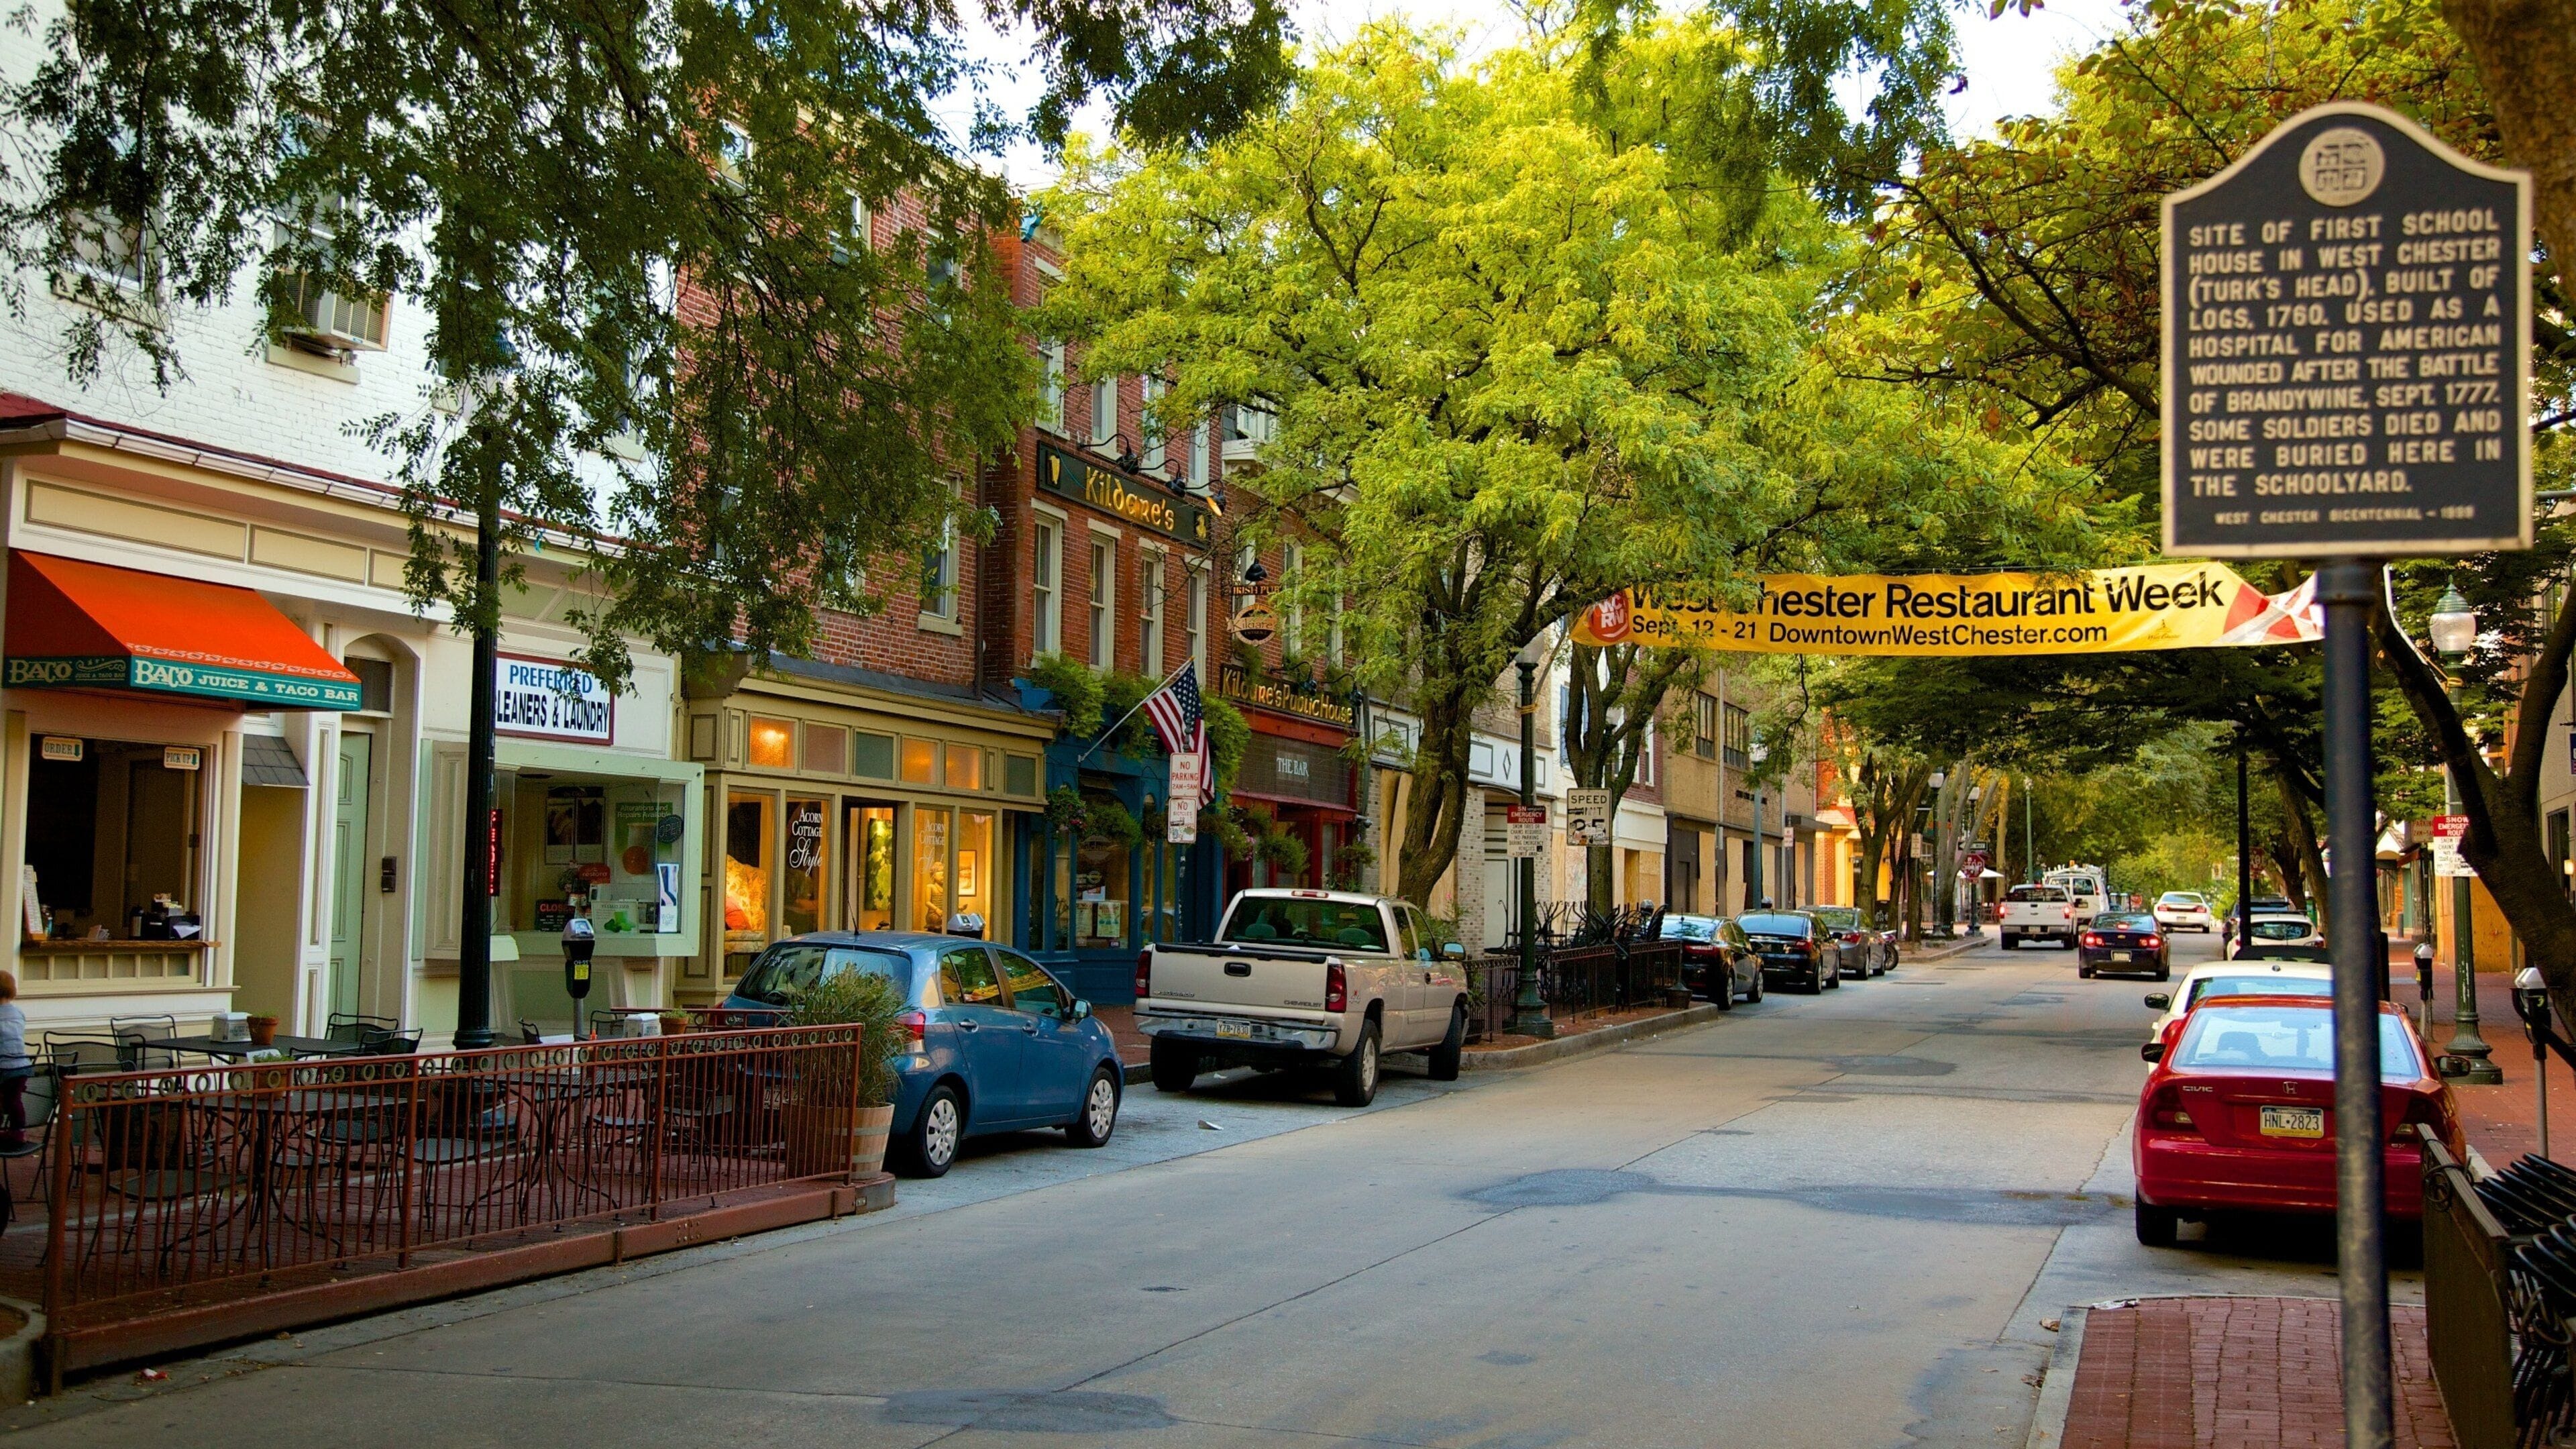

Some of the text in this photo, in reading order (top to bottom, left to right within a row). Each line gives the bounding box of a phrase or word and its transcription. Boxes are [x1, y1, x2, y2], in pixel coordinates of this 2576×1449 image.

[2190, 209, 2500, 246] SITE OF FIRST SCHOOL
[2190, 238, 2500, 274] HOUSE IN WEST CHESTER
[2386, 270, 2451, 293] BUILT
[2470, 267, 2500, 288] OF
[2346, 300, 2412, 323] USED
[2430, 298, 2462, 319] AS
[2483, 294, 2500, 317] A
[2190, 325, 2500, 357] HOSPITAL FOR AMERICAN
[2190, 353, 2500, 384] WOUNDED AFTER THE BATTLE
[2190, 392, 2218, 414] OF
[2190, 409, 2501, 441] SOME SOLDIERS DIED AND
[2190, 438, 2500, 469] WERE BURIED HERE IN
[2190, 475, 2237, 496] THE
[1086, 466, 1174, 531] Kildare's
[2215, 512, 2249, 525] WEST
[2261, 509, 2318, 523] CHESTER
[1234, 586, 1258, 594] IRISH
[1742, 581, 1876, 618] hester
[1886, 581, 2094, 619] Restaurant
[2104, 572, 2224, 612] Week
[1734, 621, 1756, 639] 21
[1770, 623, 2107, 645] DowntownWestChester.com
[9, 659, 73, 684] BACO
[135, 659, 358, 702] BACO JUICE & TACO BAR
[510, 664, 592, 693] PREFERRD
[496, 690, 609, 733] LEANERS & LAUNDRY
[44, 742, 73, 755] ORDER
[166, 751, 191, 764] PICK UP
[1172, 772, 1198, 781] PARKING
[1180, 761, 1191, 770] NO
[1277, 757, 1309, 777] THE BAR
[1178, 801, 1187, 810] NO
[1571, 795, 1607, 804] SPEED
[798, 807, 824, 823] ACORN
[792, 820, 823, 837] COTTAGE
[790, 837, 822, 877] Style
[2182, 1085, 2213, 1093] CIVIC
